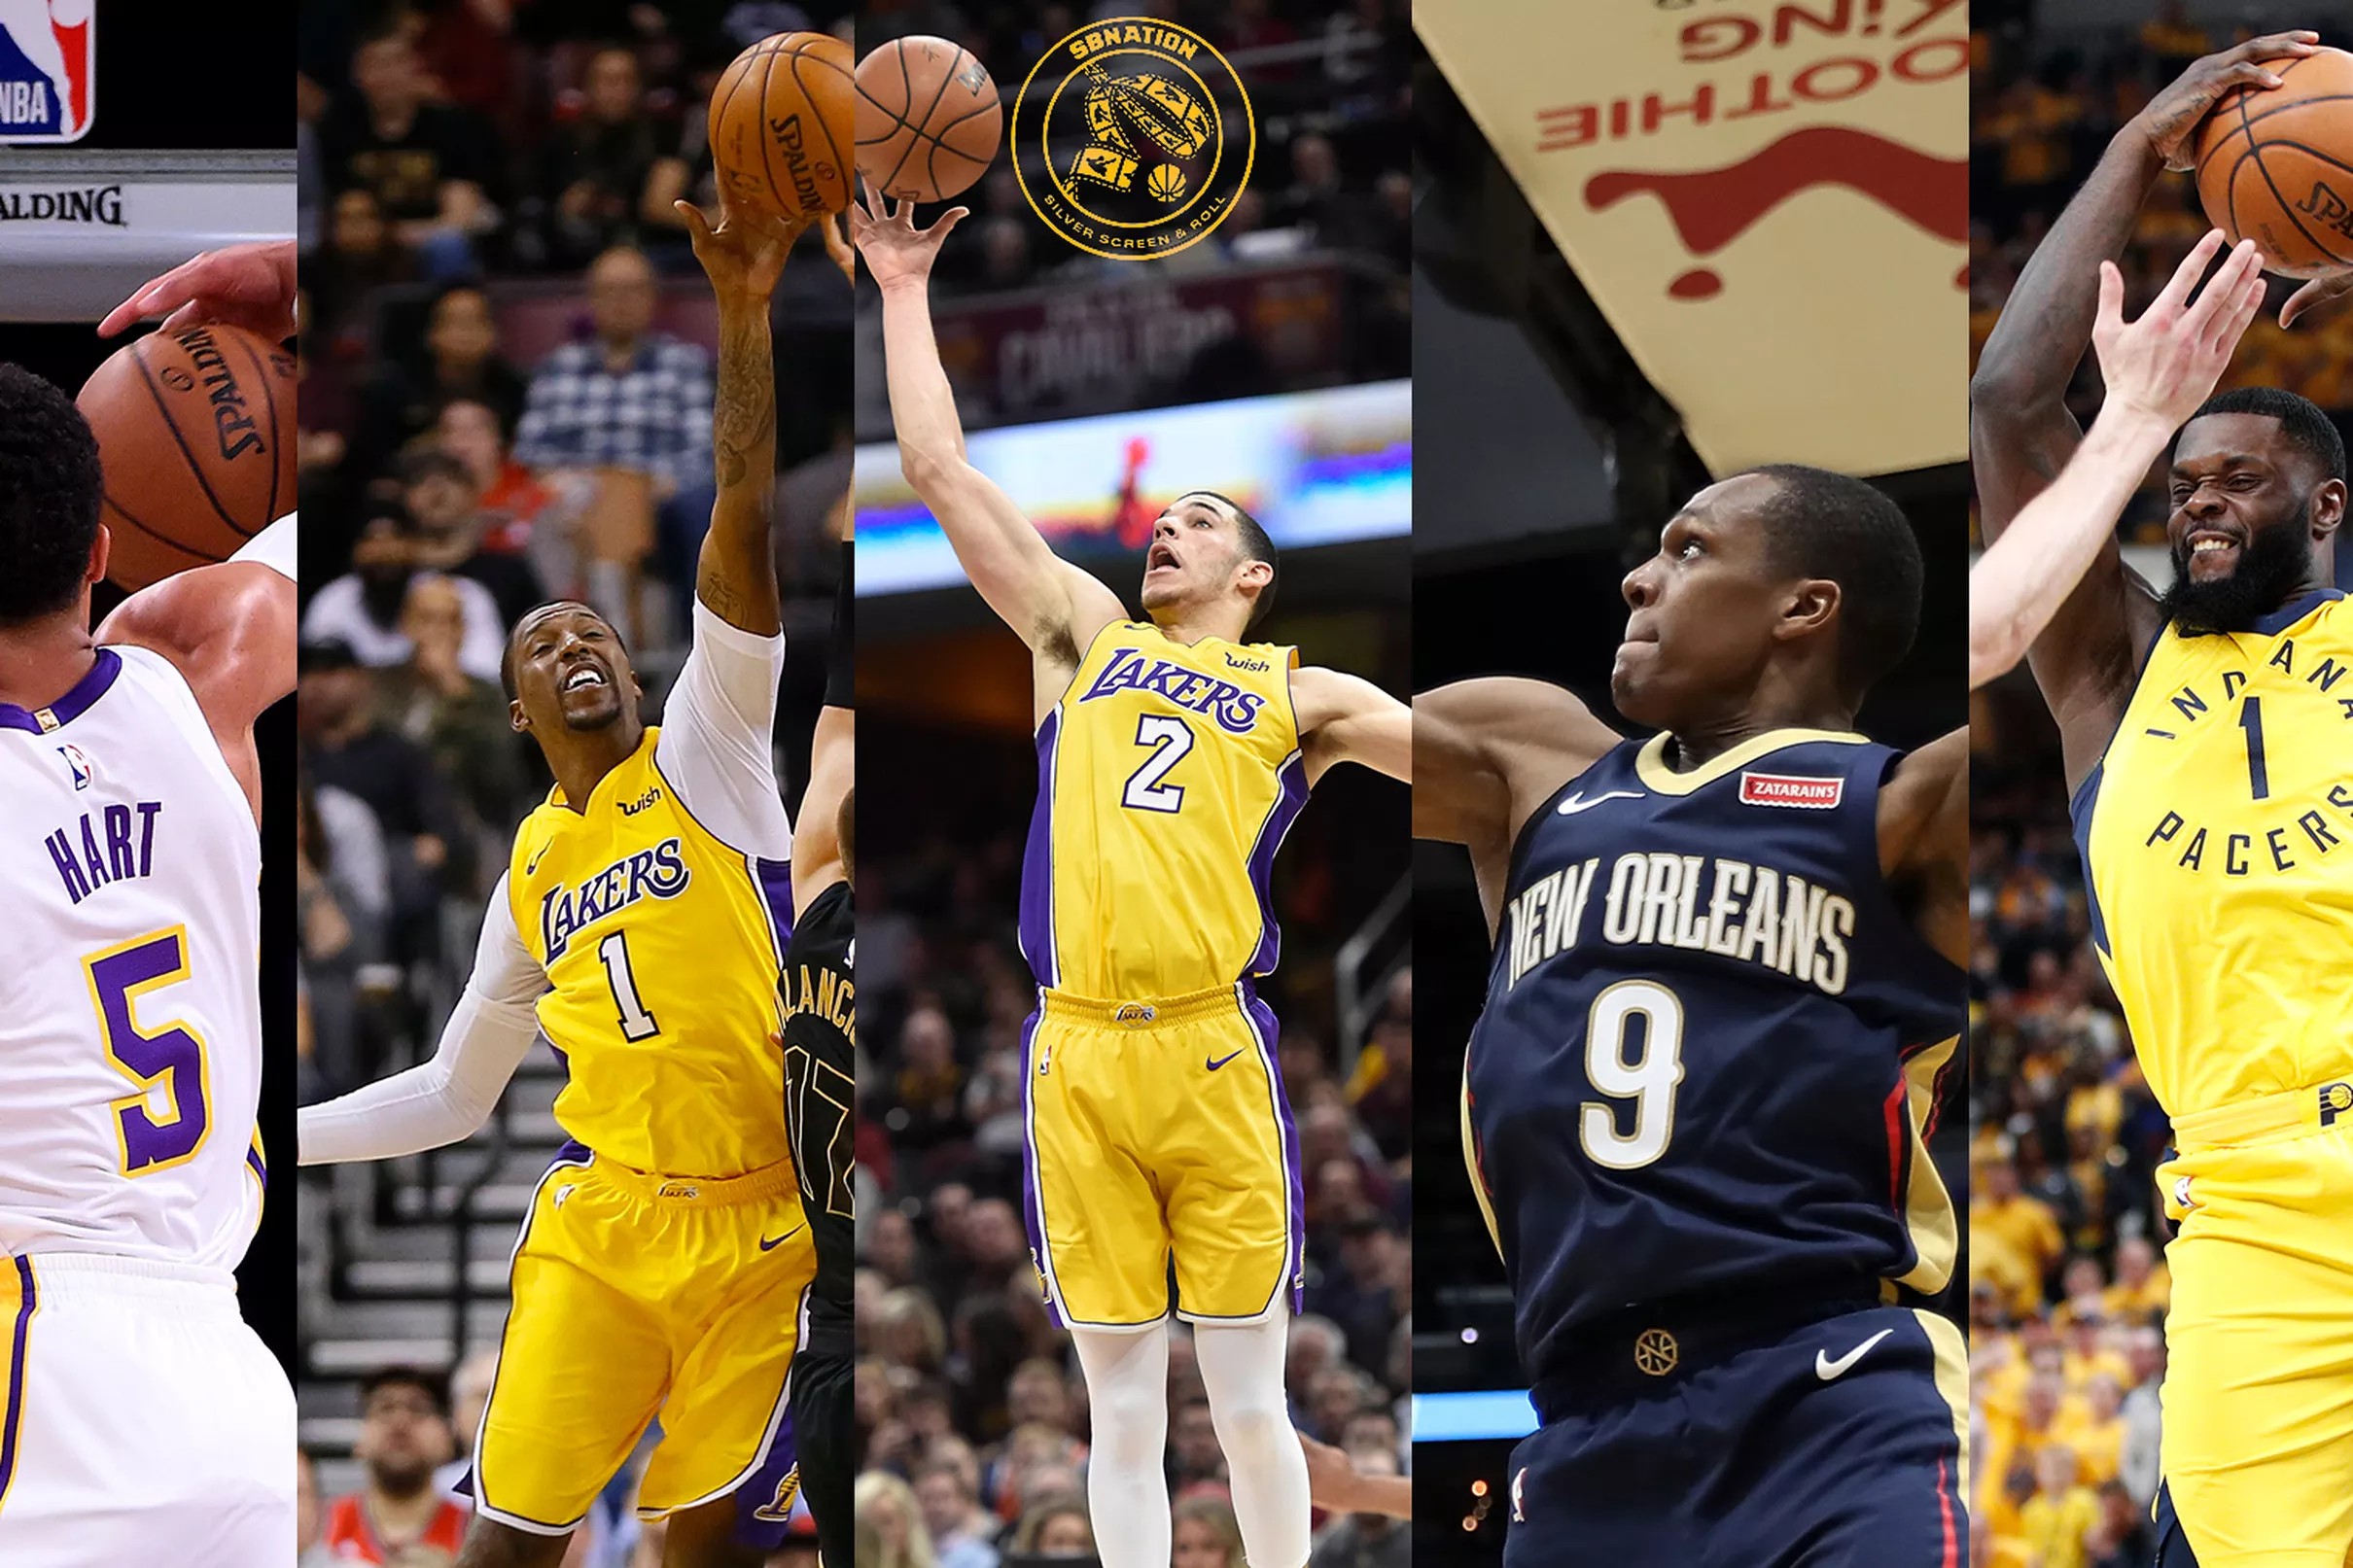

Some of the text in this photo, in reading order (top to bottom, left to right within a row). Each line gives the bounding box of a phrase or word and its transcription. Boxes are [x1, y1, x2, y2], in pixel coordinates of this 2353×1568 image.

[770, 113, 827, 214] SPALDIN
[173, 325, 266, 461] SPALDIN
[1078, 645, 1265, 733] LAKERS
[1224, 651, 1270, 672] wish
[616, 785, 661, 816] wish
[1120, 713, 1194, 815] 2
[2238, 696, 2269, 800] 1
[44, 801, 161, 906] HART
[541, 836, 691, 969] LAKERS
[1507, 852, 1855, 995] NEW ORLEANS
[599, 929, 661, 1043] 1
[80, 923, 213, 1178] 5
[1579, 979, 1685, 1169] 9
